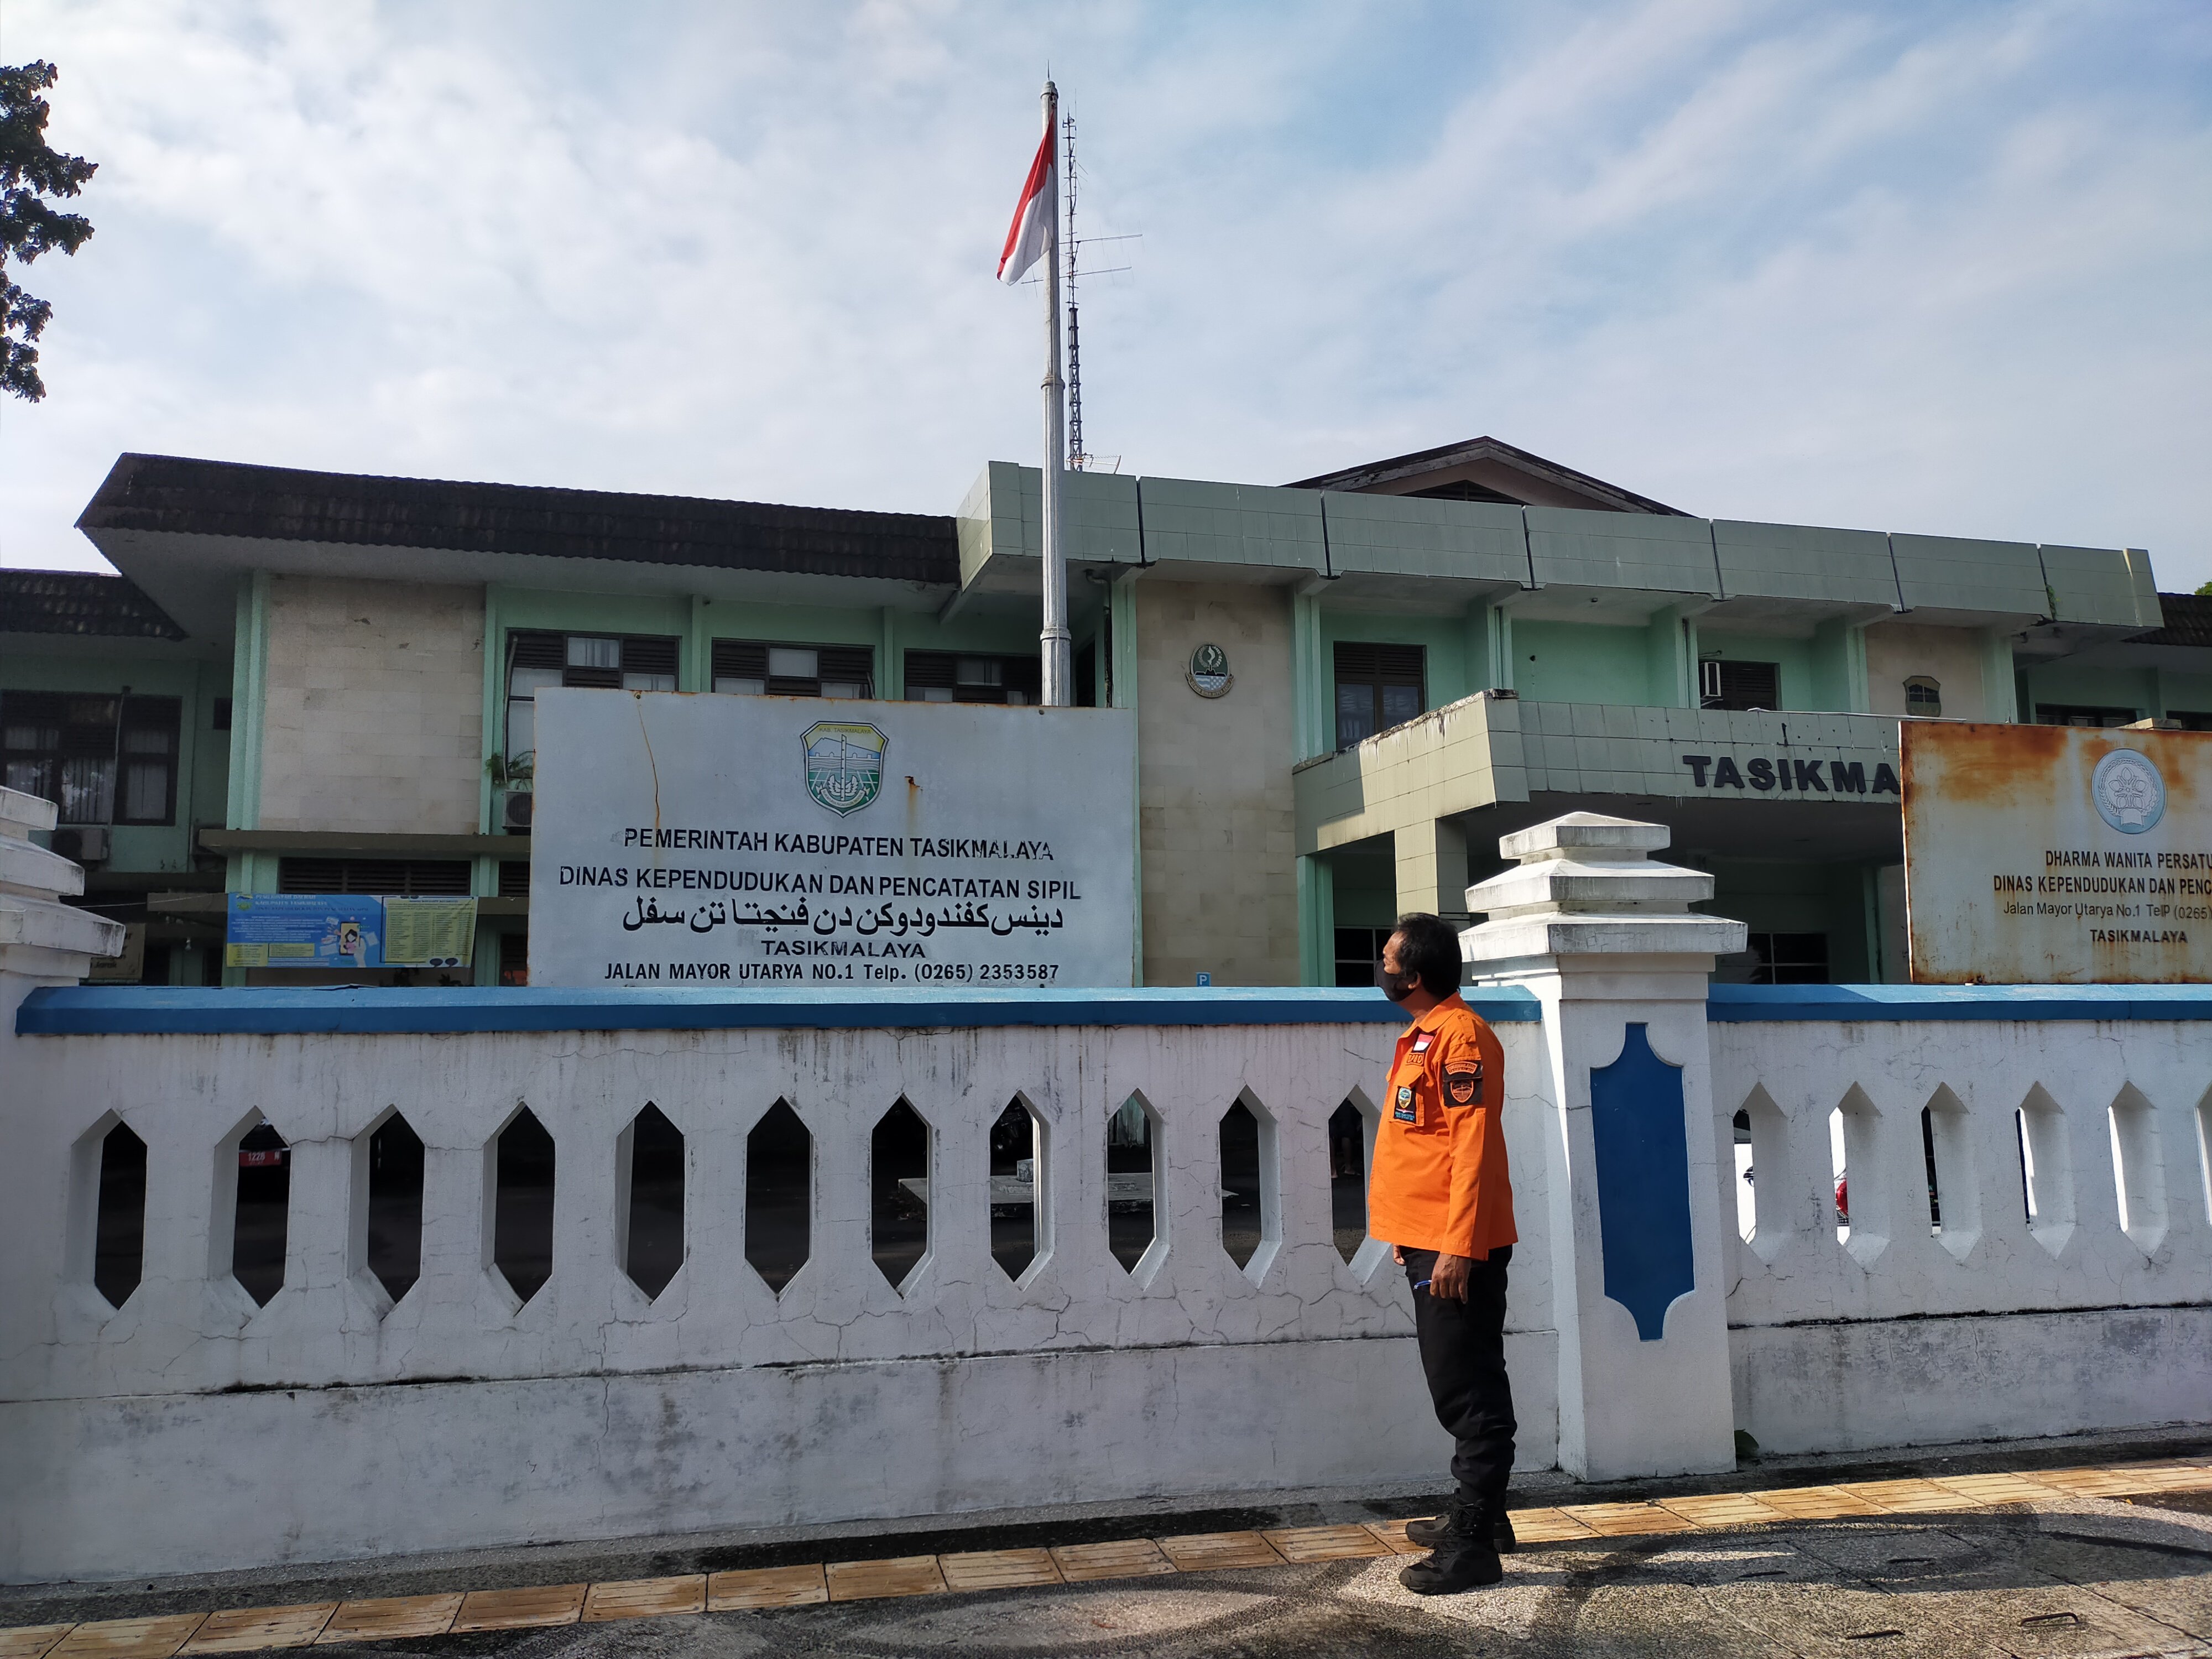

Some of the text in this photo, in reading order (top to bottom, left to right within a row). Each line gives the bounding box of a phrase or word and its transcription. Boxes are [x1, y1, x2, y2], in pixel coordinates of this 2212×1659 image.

[1682, 755, 1901, 794] TASIKMA
[624, 828, 1054, 860] PEMERINTAH KABUPATEN TASIKMALAYA
[2046, 851, 2100, 867] DHARMA
[2104, 852, 2153, 868] WANITA
[560, 865, 1082, 900] DINAS KEPENDUDUKAN DAN PENCATATAN SIPIL
[1994, 875, 2033, 892] DINAS
[2038, 876, 2145, 893] KEPENDUDUKAN
[2149, 878, 2175, 894] DAN
[2004, 901, 2034, 915] Jalan
[2037, 902, 2073, 917] Mayor
[2075, 902, 2114, 919] Utarya
[2116, 904, 2140, 917] No.1
[2090, 929, 2188, 943] TASIKMALAYA
[761, 940, 926, 958] TASIKMALAYA
[605, 963, 1059, 983] JALAN MAYOR UTARYA NO.1 Telp. (0265) 2353587
[1199, 974, 1207, 985] P
